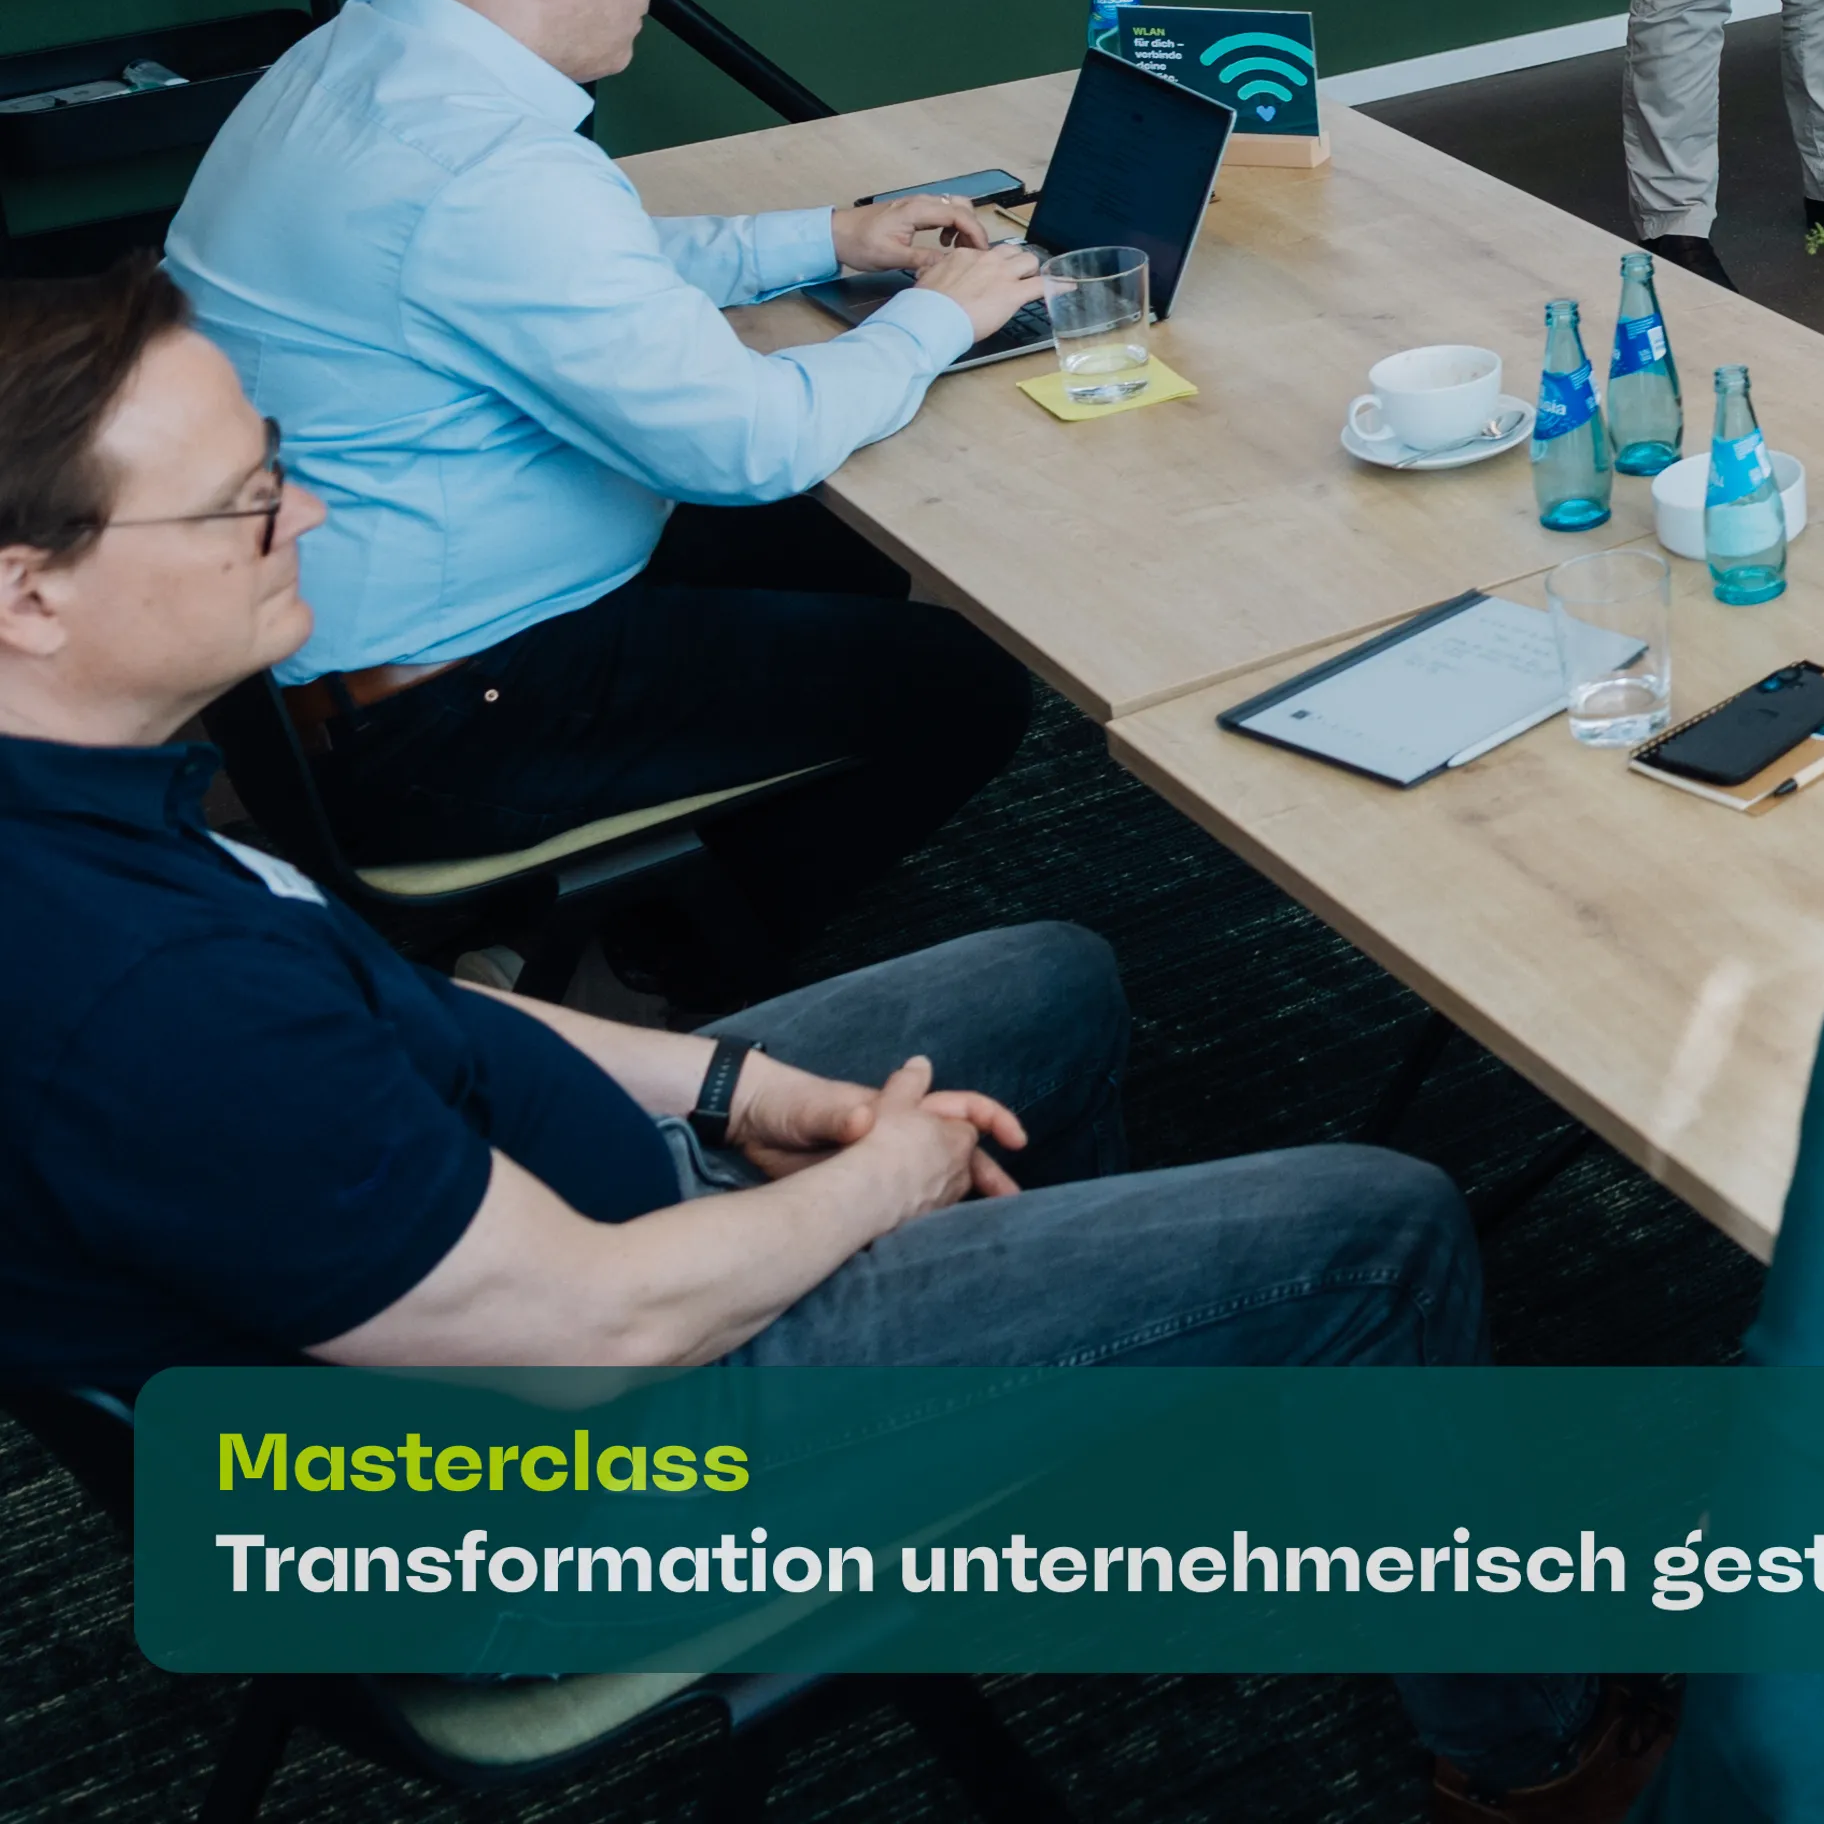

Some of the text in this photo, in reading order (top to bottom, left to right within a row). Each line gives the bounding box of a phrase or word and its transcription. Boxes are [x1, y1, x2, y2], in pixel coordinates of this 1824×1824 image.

[1132, 26, 1166, 37] WLAN
[1133, 37, 1150, 47] für
[1150, 38, 1175, 48] dich
